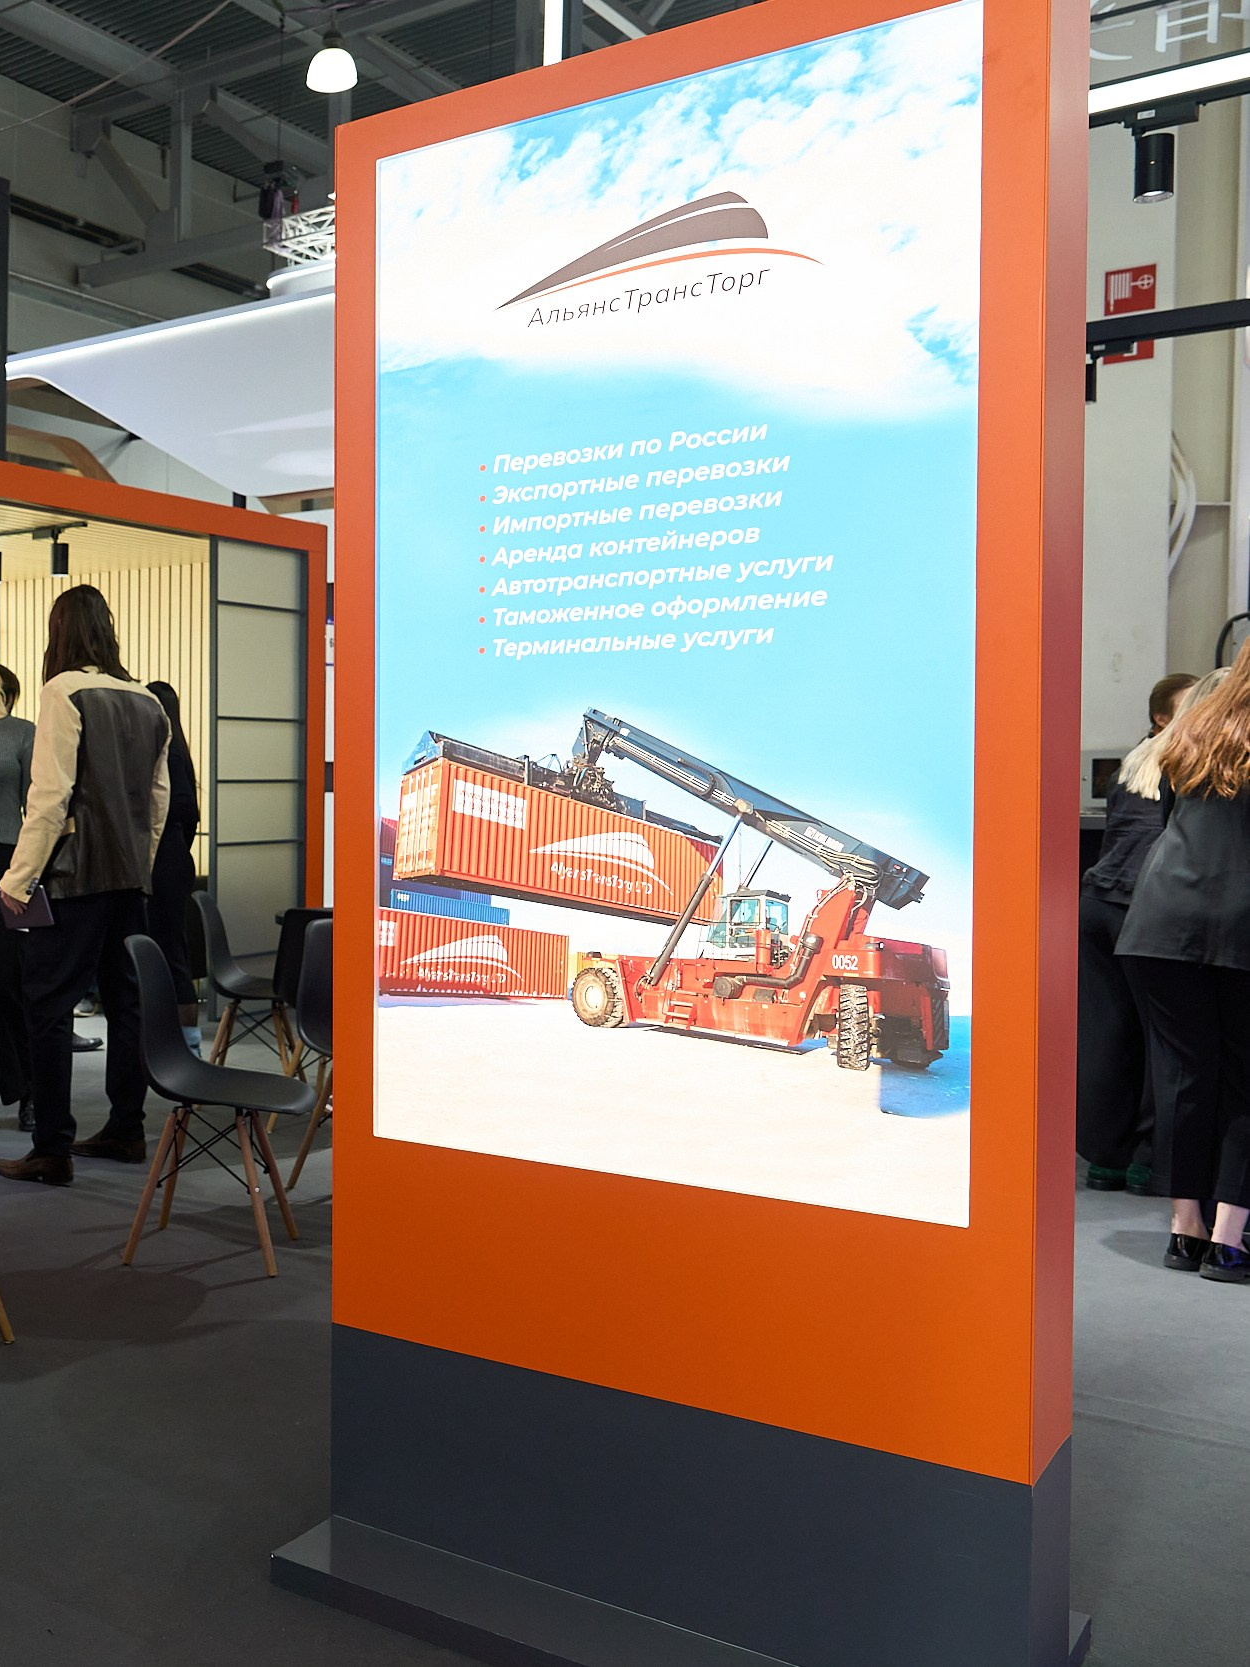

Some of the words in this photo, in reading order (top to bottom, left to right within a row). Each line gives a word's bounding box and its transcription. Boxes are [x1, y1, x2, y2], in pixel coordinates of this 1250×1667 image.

[527, 268, 771, 328] АльянсТрансТорг
[492, 443, 624, 475] Перевозки
[630, 438, 662, 457] по
[668, 423, 768, 452] России
[492, 473, 640, 505] Экспортные
[645, 455, 791, 488] перевозки
[493, 506, 633, 536] Импортные
[639, 490, 783, 522] перевозки
[491, 543, 584, 569] Аренда
[589, 527, 761, 558] контейнеров
[490, 562, 732, 597] Автотранспортные
[735, 554, 834, 583] услуги
[492, 602, 645, 627] Таможенное
[651, 589, 828, 620] оформление
[492, 632, 677, 661] Терминальные
[680, 627, 775, 653] услуги
[831, 954, 859, 971] 0052
